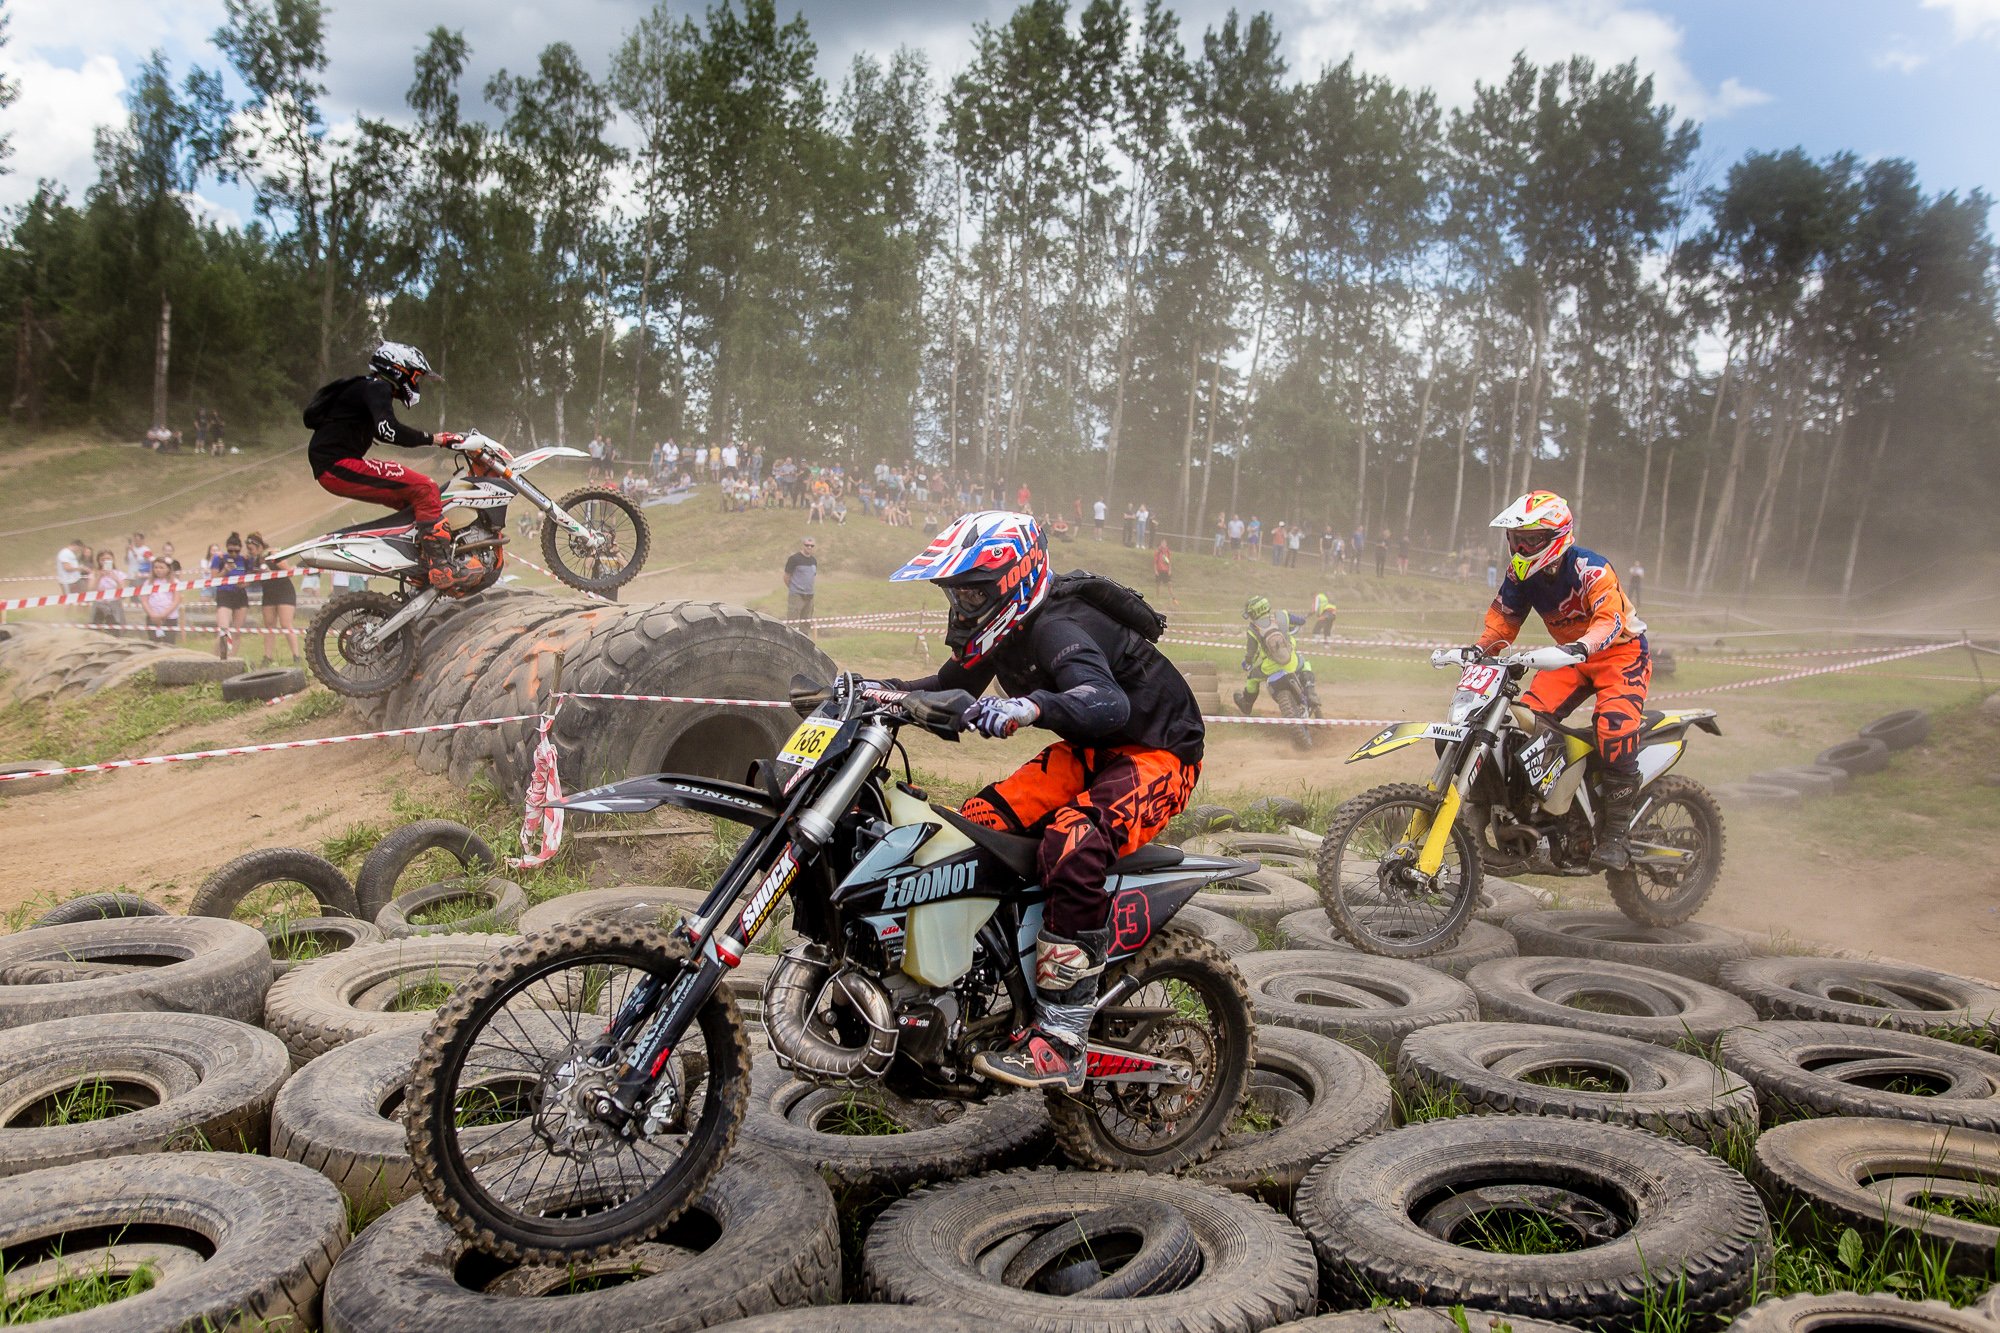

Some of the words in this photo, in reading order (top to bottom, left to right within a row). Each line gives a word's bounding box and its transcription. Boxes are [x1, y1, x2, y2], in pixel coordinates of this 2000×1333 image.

[997, 545, 1043, 595] 100%
[674, 784, 763, 809] DUNLOP
[742, 849, 798, 932] SHOCK
